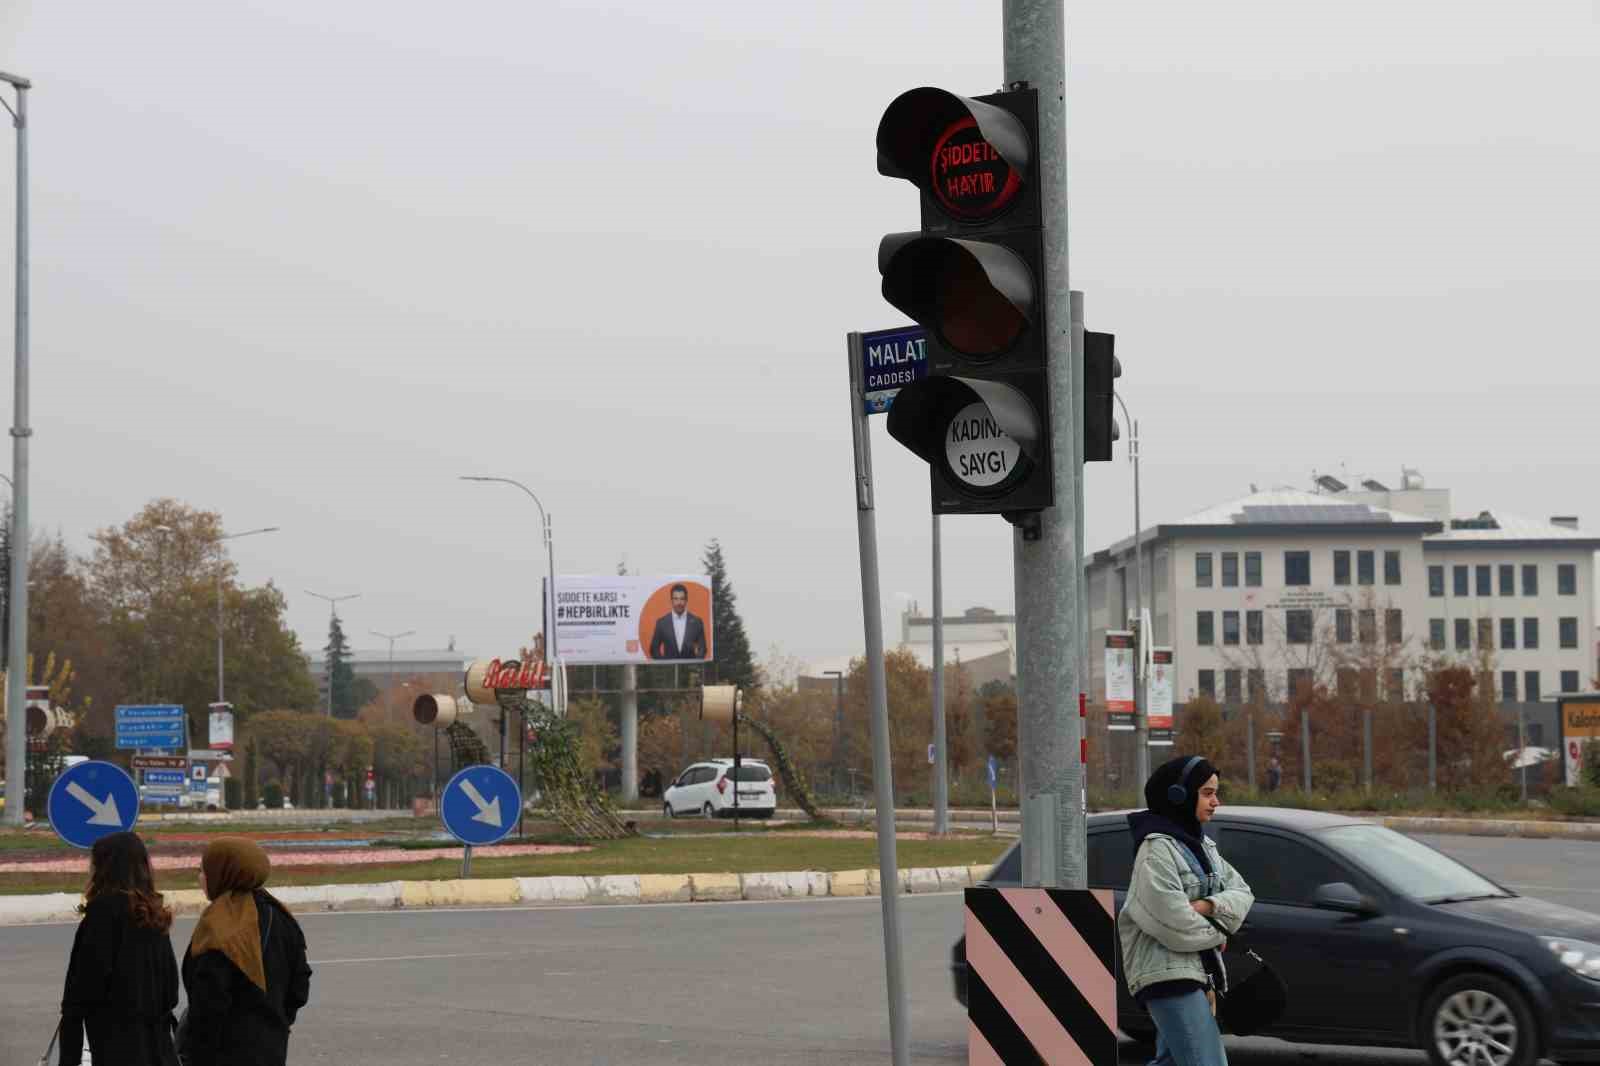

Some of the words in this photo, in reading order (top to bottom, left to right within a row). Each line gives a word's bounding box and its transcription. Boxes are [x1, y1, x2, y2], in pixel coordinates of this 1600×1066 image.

[947, 172, 996, 198] HAYIR
[869, 338, 926, 367] MALAT
[869, 367, 915, 387] CADDESİ
[960, 450, 1006, 476] SAYGI
